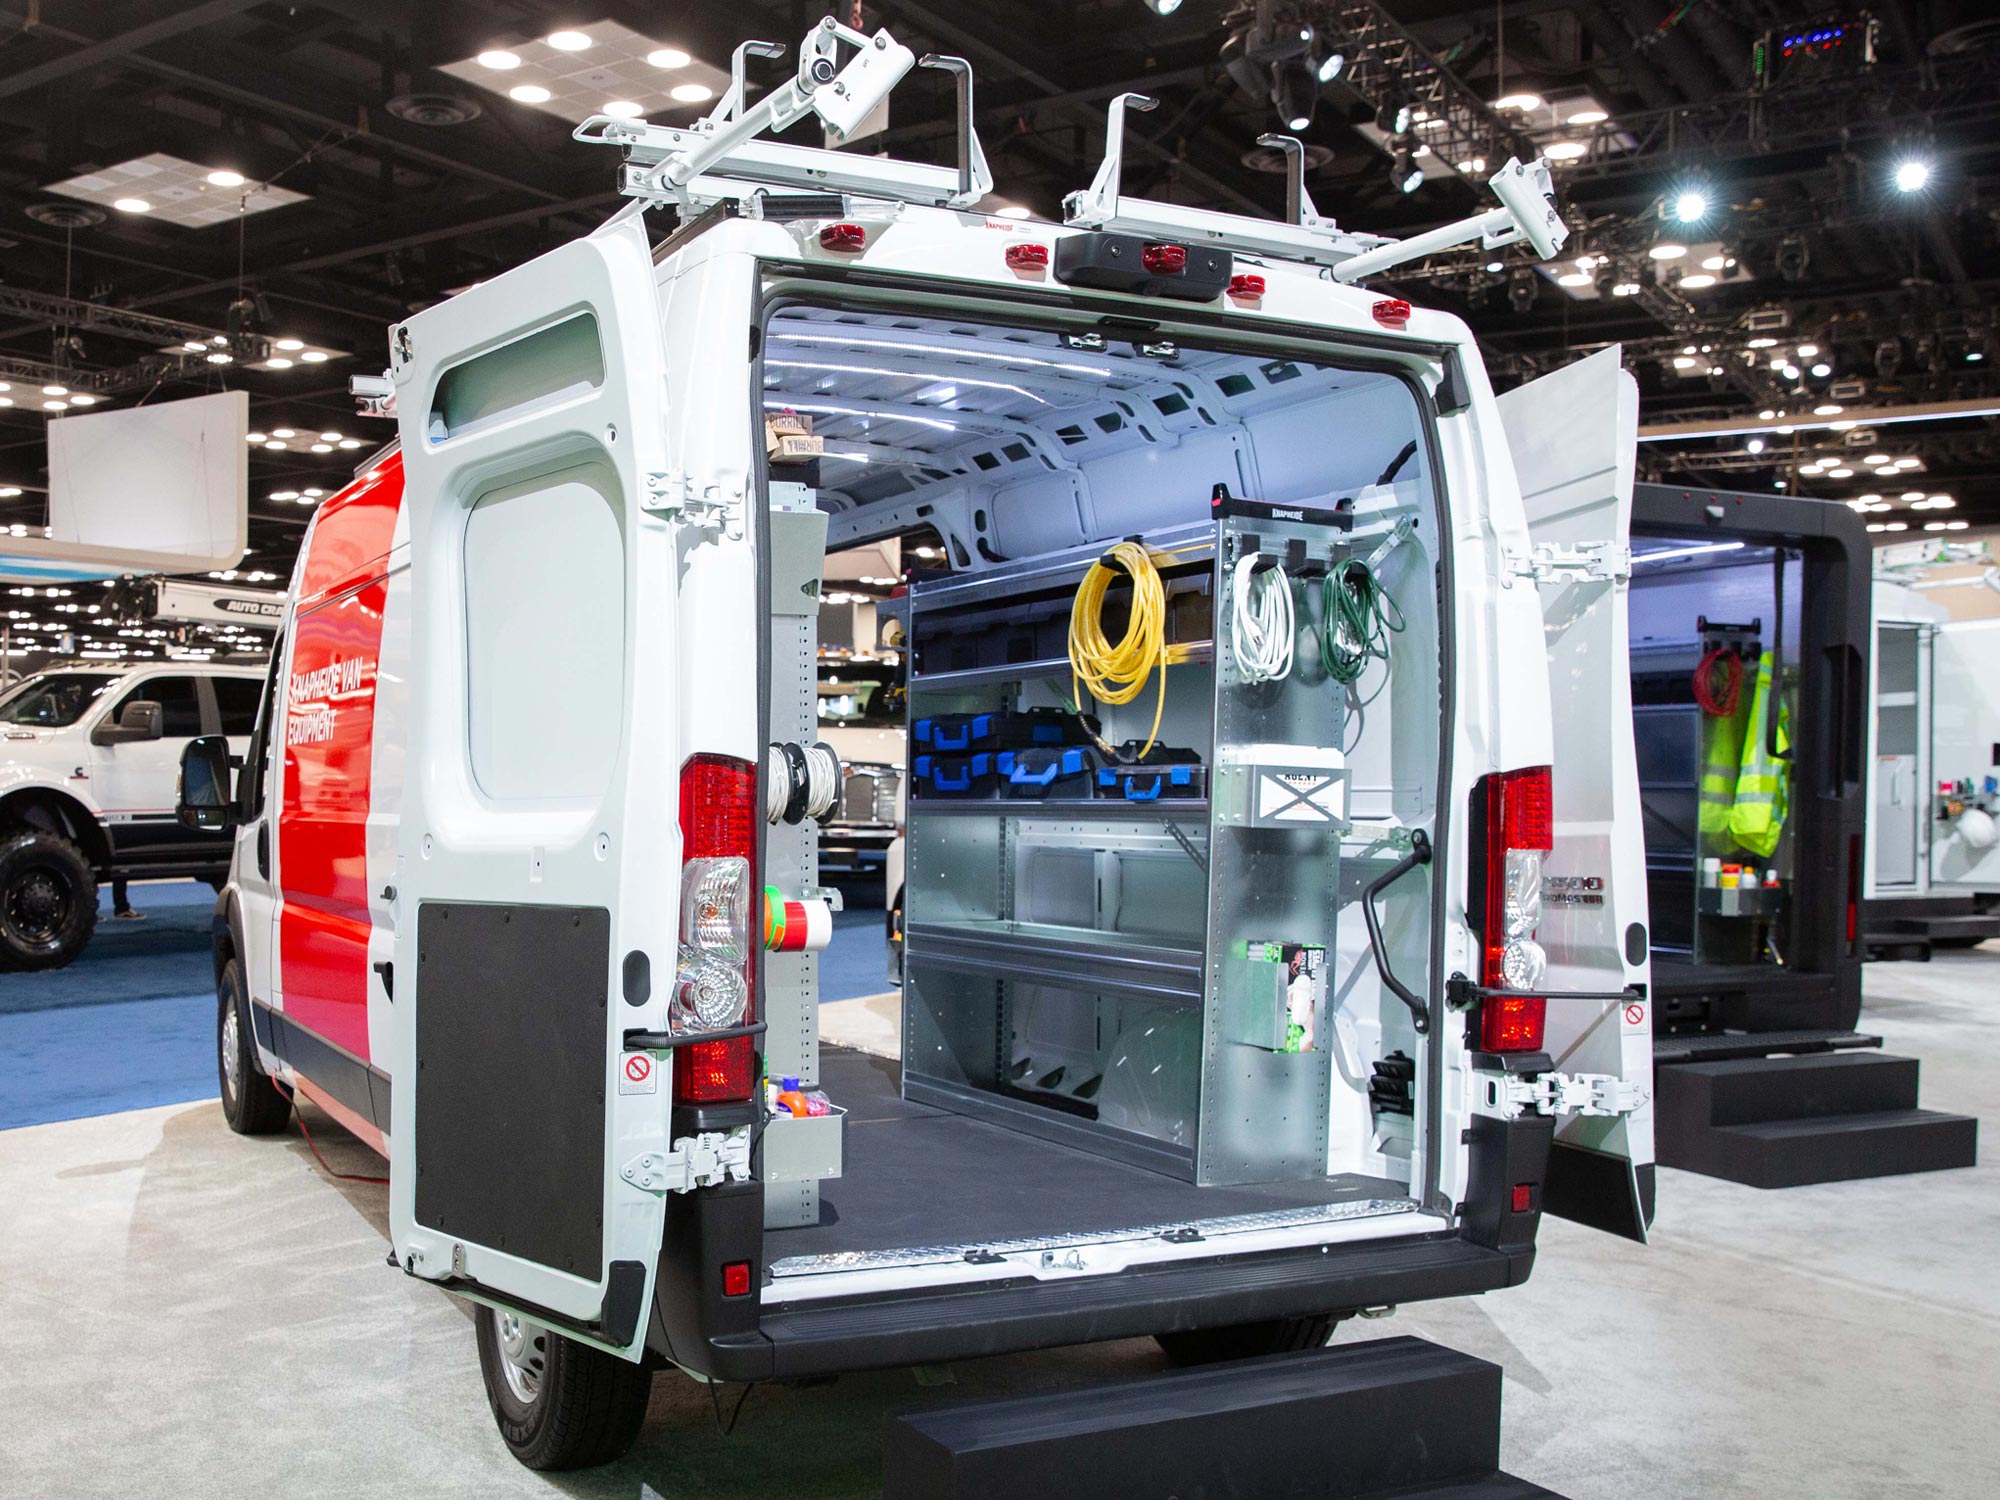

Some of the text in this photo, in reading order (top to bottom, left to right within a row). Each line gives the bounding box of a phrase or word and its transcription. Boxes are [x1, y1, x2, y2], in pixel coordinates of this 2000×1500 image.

[226, 600, 260, 614] AUTO
[341, 656, 363, 693] VAN
[287, 708, 337, 746] EQUIPMENT
